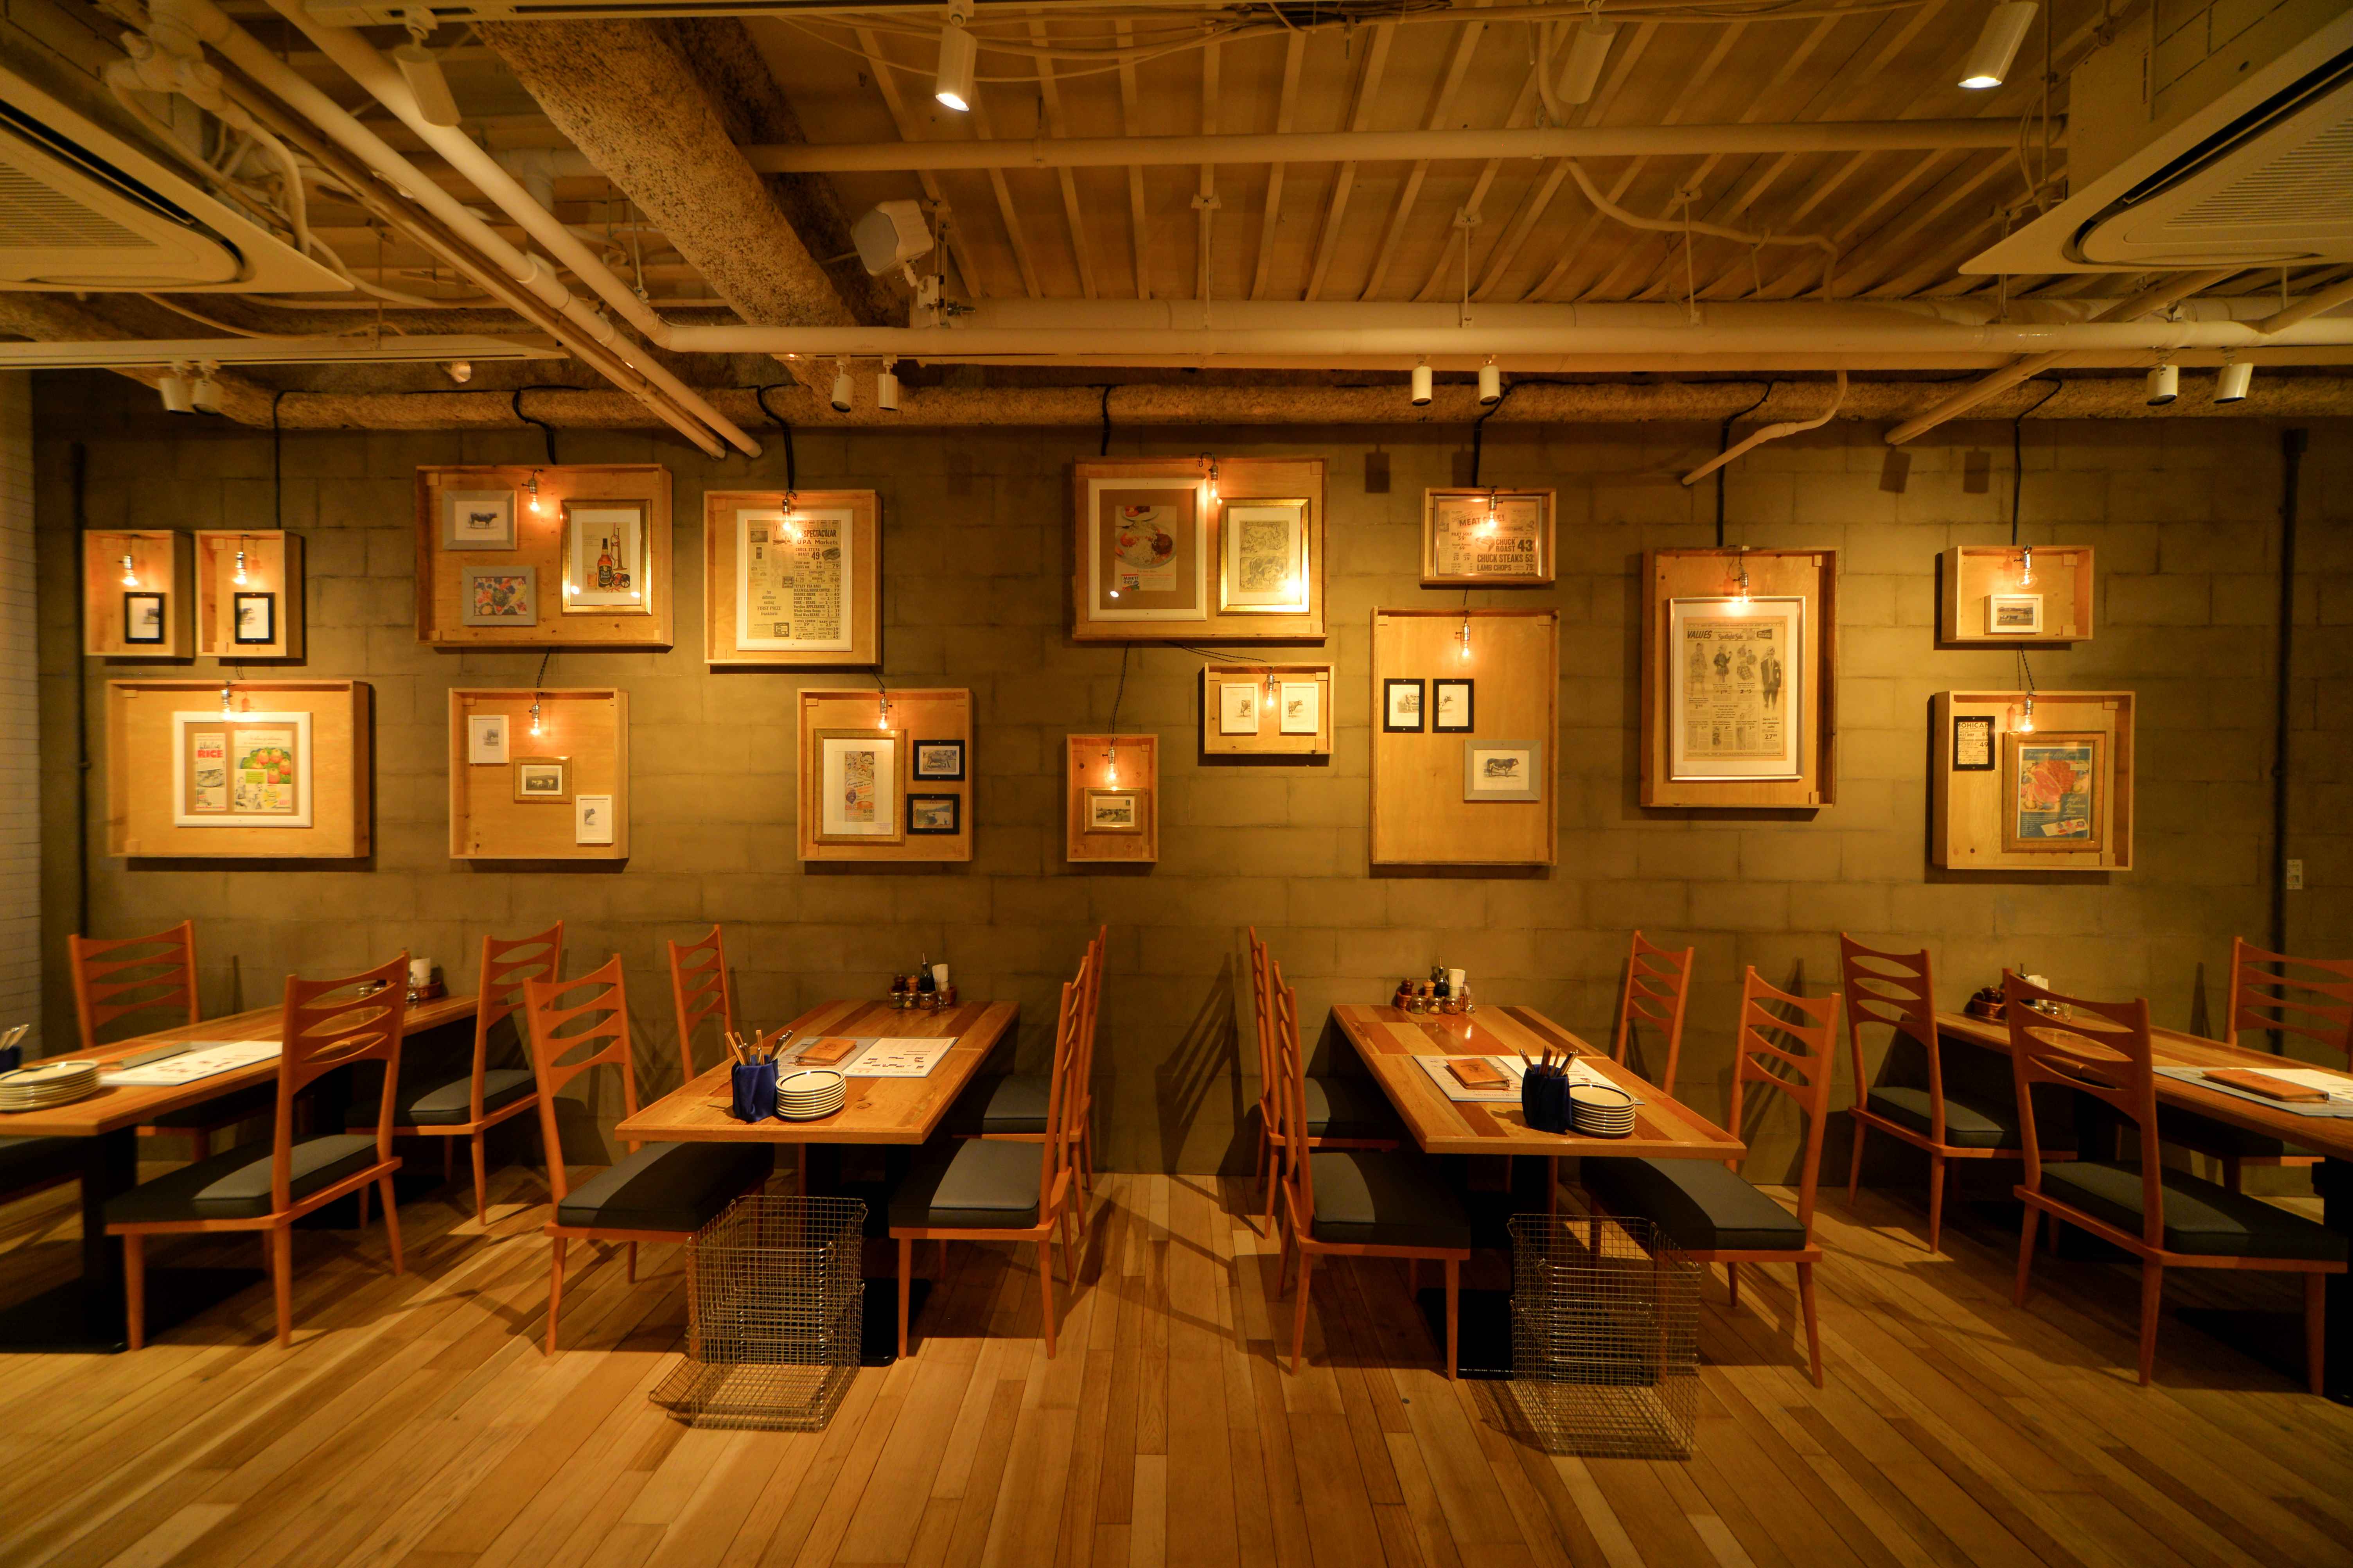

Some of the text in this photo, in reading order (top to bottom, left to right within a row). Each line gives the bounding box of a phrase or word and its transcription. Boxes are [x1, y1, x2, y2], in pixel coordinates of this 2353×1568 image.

[1459, 517, 1480, 526] MEAT
[1518, 540, 1533, 552] 43
[812, 552, 819, 560] 49
[1477, 554, 1533, 563] CHUCK STEAKS 53
[1687, 630, 1712, 639] VALUES
